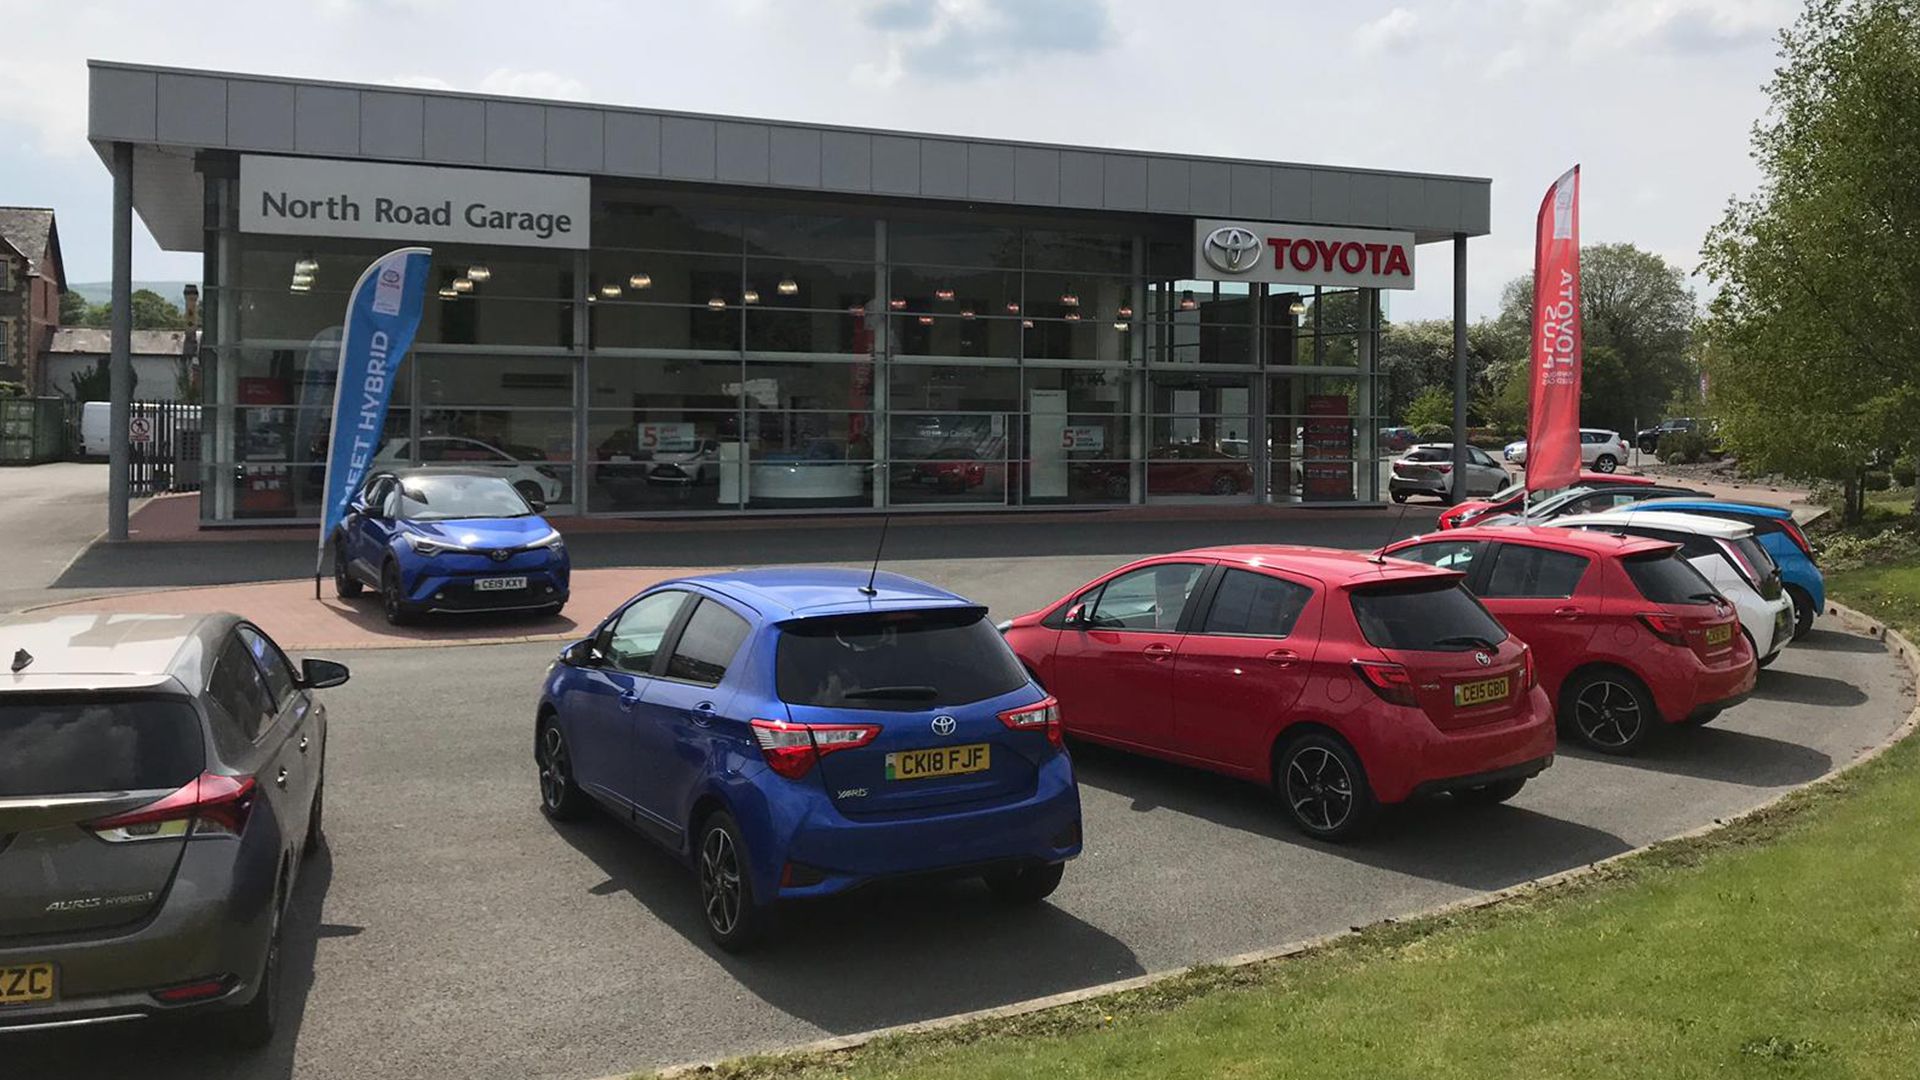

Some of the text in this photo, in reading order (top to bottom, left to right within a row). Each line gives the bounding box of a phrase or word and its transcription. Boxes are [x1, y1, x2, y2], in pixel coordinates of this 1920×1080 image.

[261, 190, 571, 239] North Road Garage
[1267, 237, 1411, 276] TOYOTA
[358, 330, 389, 431] HYBRID
[643, 427, 657, 447] 5
[1062, 429, 1074, 448] 5
[1463, 683, 1485, 702] CE15
[902, 747, 984, 775] CK18 FJF
[838, 787, 869, 799] YARIS
[46, 898, 101, 911] AURIS
[0, 967, 47, 997] ZC
